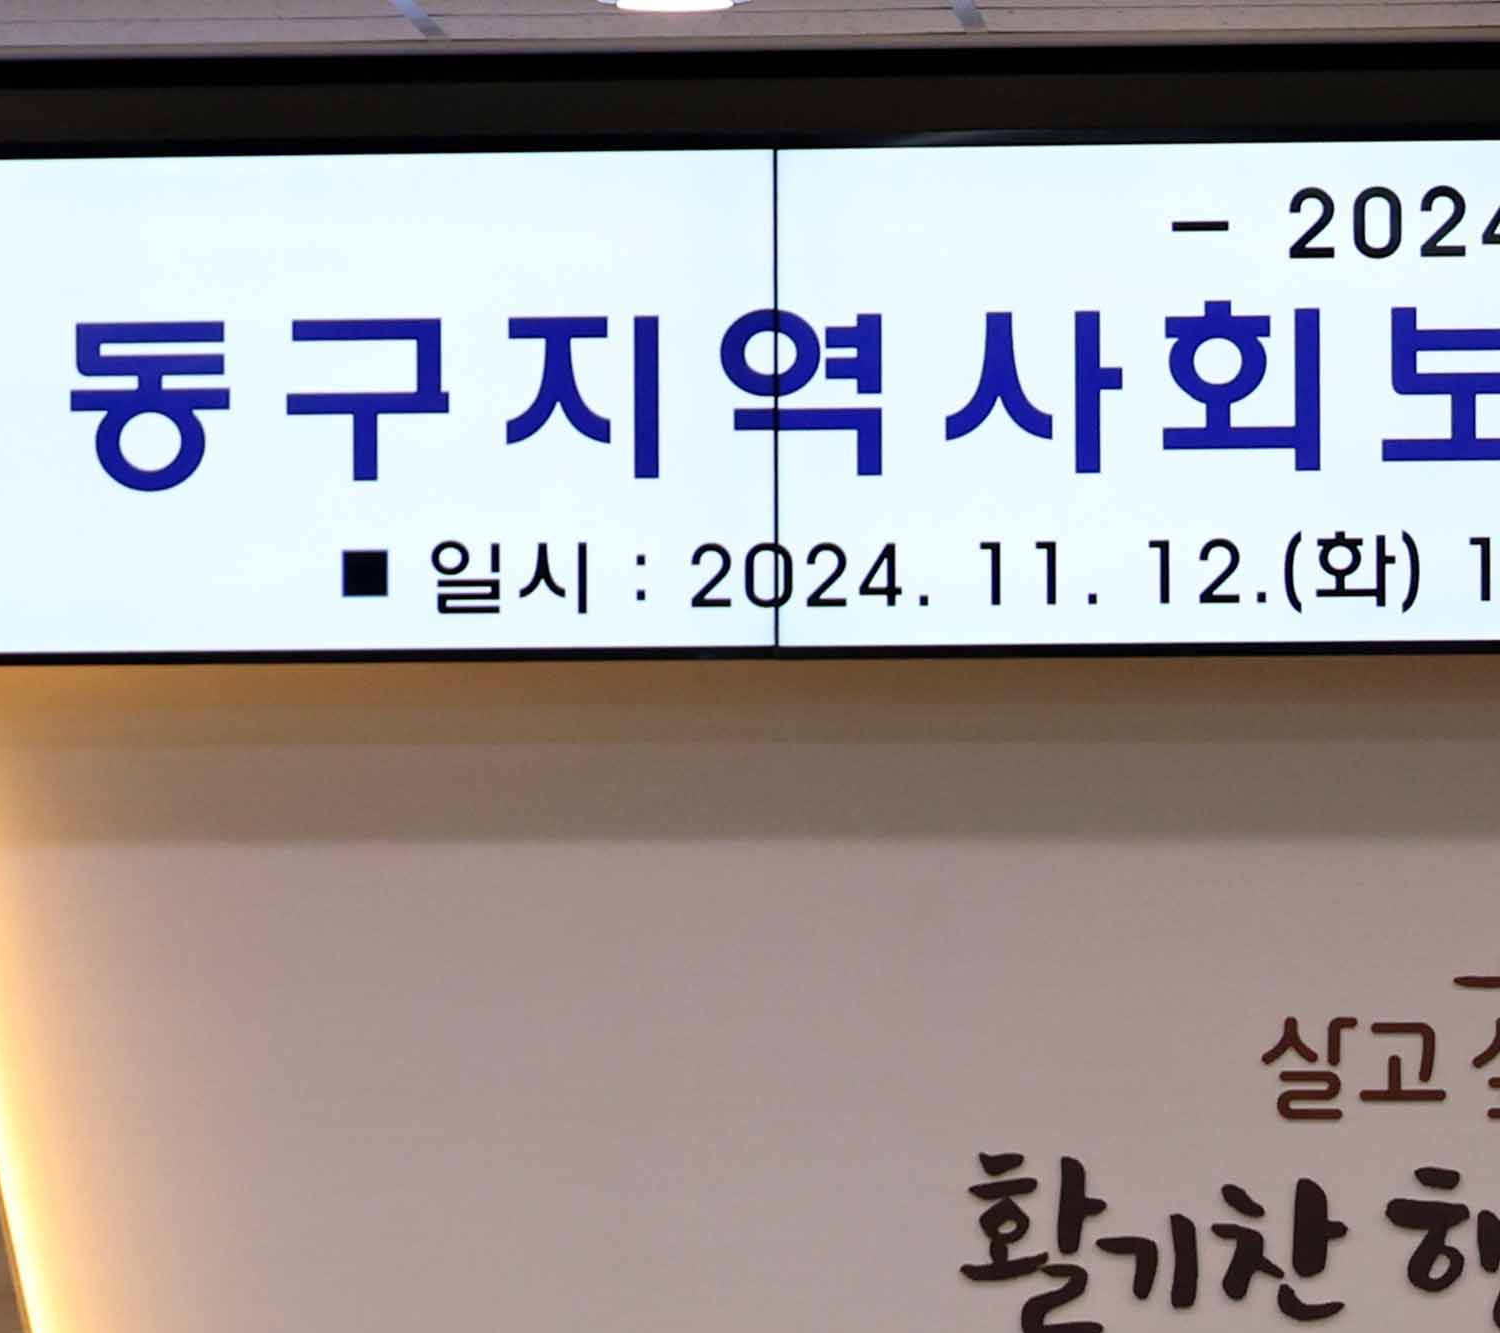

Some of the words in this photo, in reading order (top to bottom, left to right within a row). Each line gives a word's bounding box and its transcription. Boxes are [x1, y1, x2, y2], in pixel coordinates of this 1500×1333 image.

[431, 540, 588, 615] 일시
[691, 542, 929, 609] 2024.
[979, 541, 1098, 606] 11.
[1261, 1016, 1447, 1120] 살고
